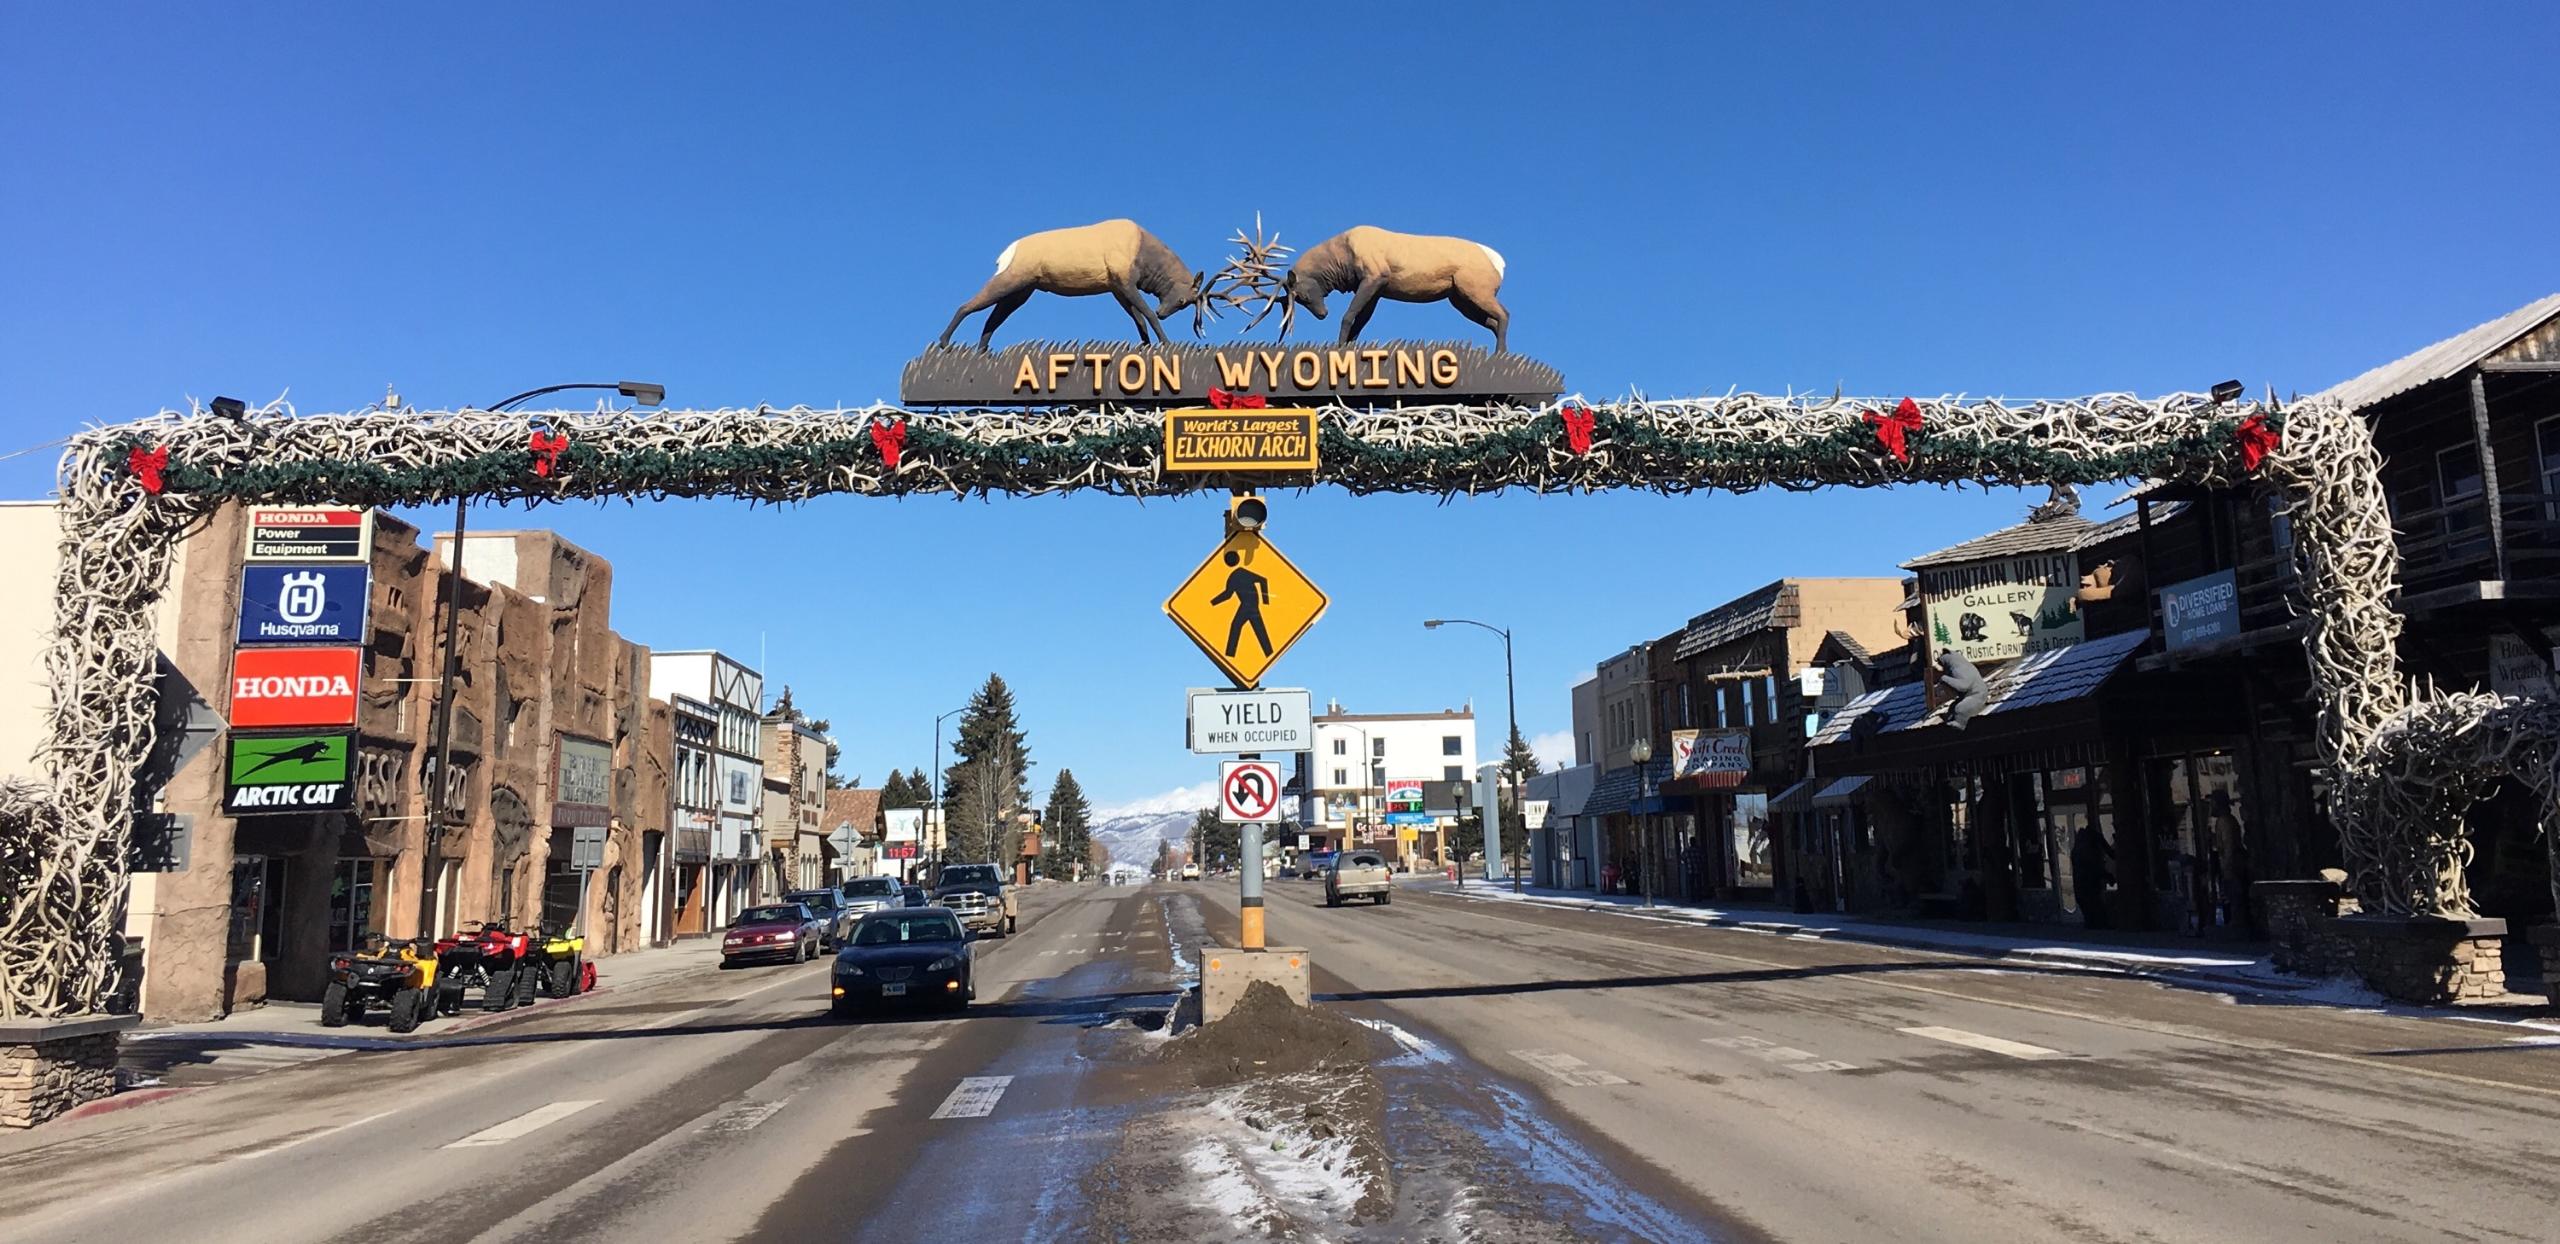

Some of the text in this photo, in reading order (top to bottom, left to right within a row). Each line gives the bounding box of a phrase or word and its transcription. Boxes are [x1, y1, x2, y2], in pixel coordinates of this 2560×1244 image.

[1013, 348, 1460, 393] AFTON WYOMING
[1183, 418, 1299, 434] World's Largest
[1176, 435, 1306, 459] ELKHORN ARCH
[257, 512, 329, 524] HONDA
[256, 528, 301, 539] Power
[255, 543, 328, 556] Equipment
[1924, 554, 2072, 605] MOUNTAIN VALLEY
[1963, 590, 2036, 608] GALLERY
[2178, 582, 2233, 611] DIVERSIFIED
[259, 621, 339, 638] Husqvarna
[234, 675, 353, 698] HONDA
[1221, 702, 1282, 725] YIELD
[1208, 729, 1297, 743] WHEN OCCUPIED
[1713, 735, 1745, 755] Creek
[231, 783, 341, 807] ARCTIC CAT
